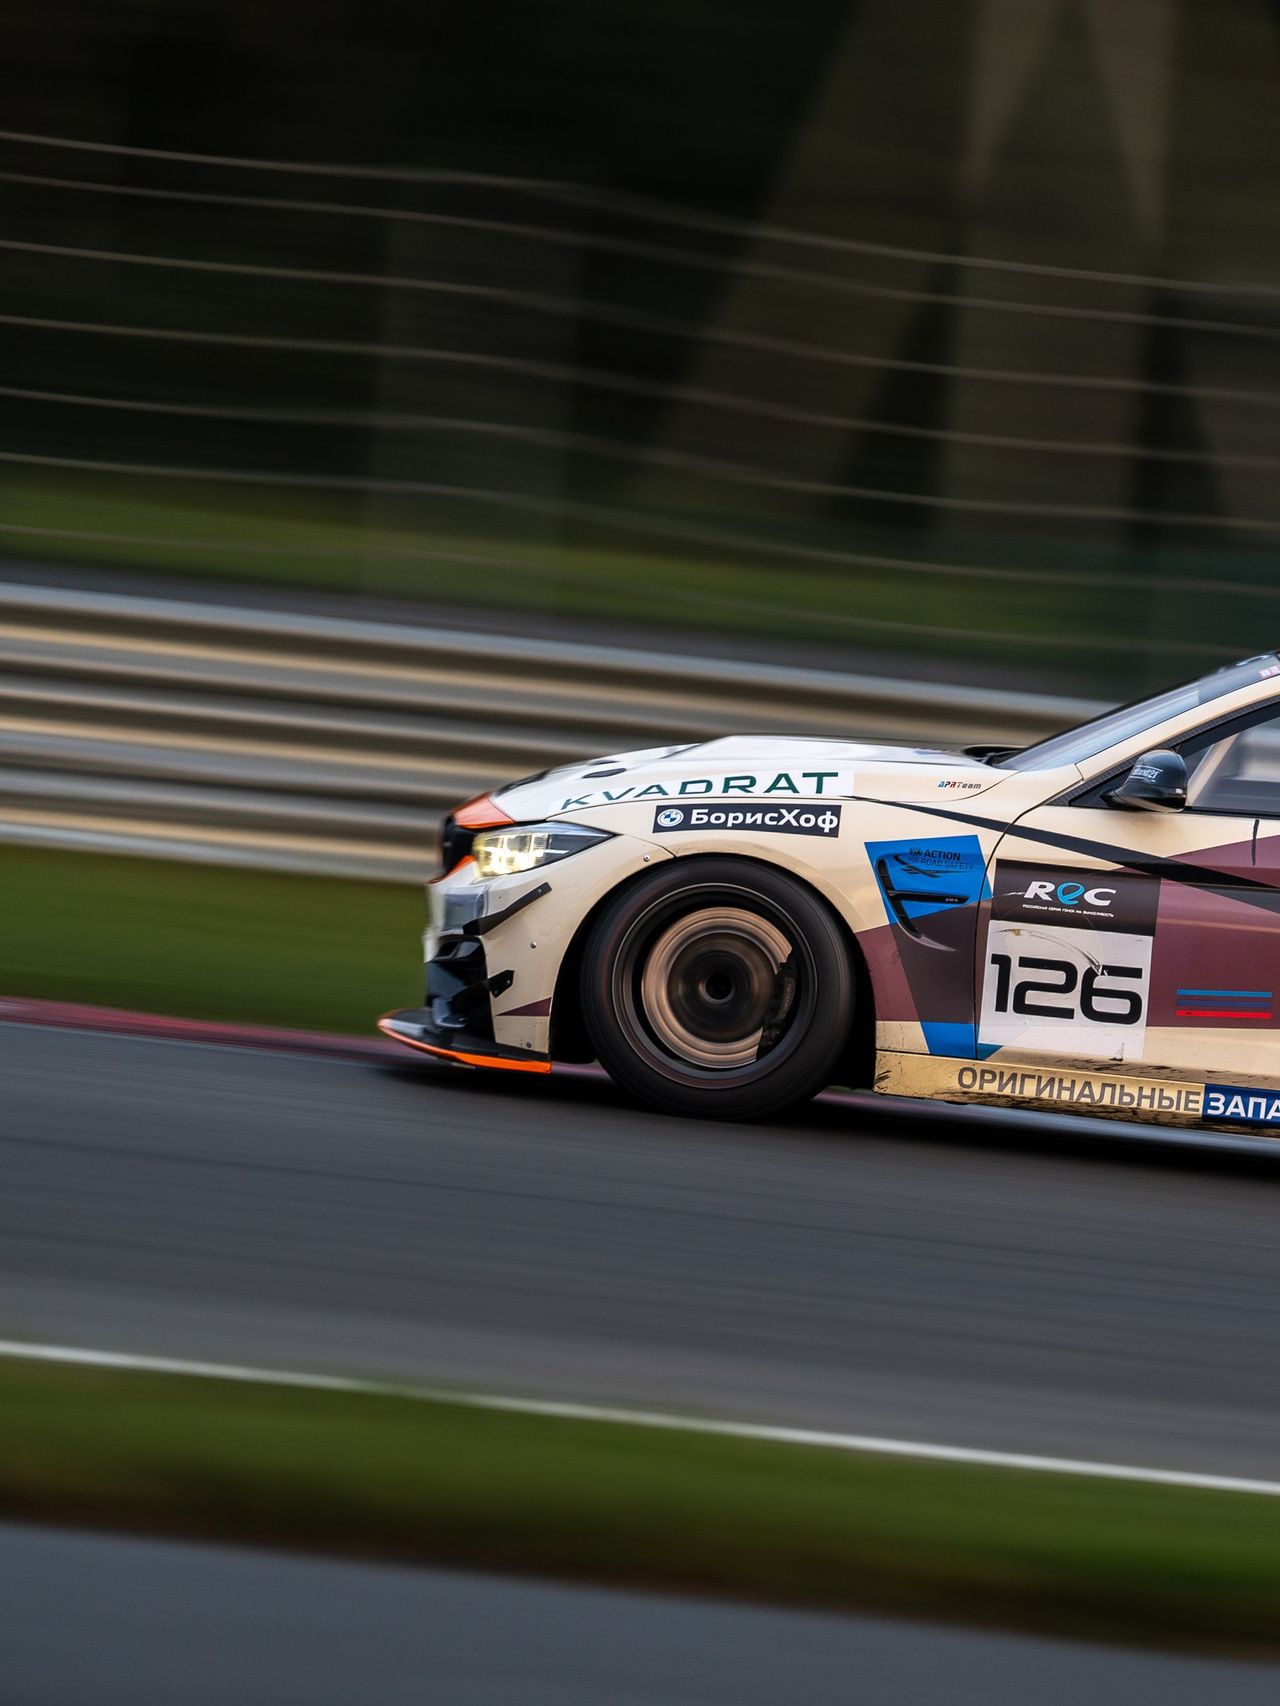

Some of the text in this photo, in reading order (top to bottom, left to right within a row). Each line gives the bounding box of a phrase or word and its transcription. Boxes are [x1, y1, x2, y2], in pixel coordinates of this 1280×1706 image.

[561, 772, 839, 810] KVADRAT
[690, 808, 839, 833] БорисХоф
[920, 858, 942, 867] ROAD
[944, 861, 975, 870] SAFETY
[924, 849, 961, 861] ACTION
[991, 953, 1143, 1025] 126
[957, 1067, 1201, 1113] ОРИГИНАЛЬНЫЕ
